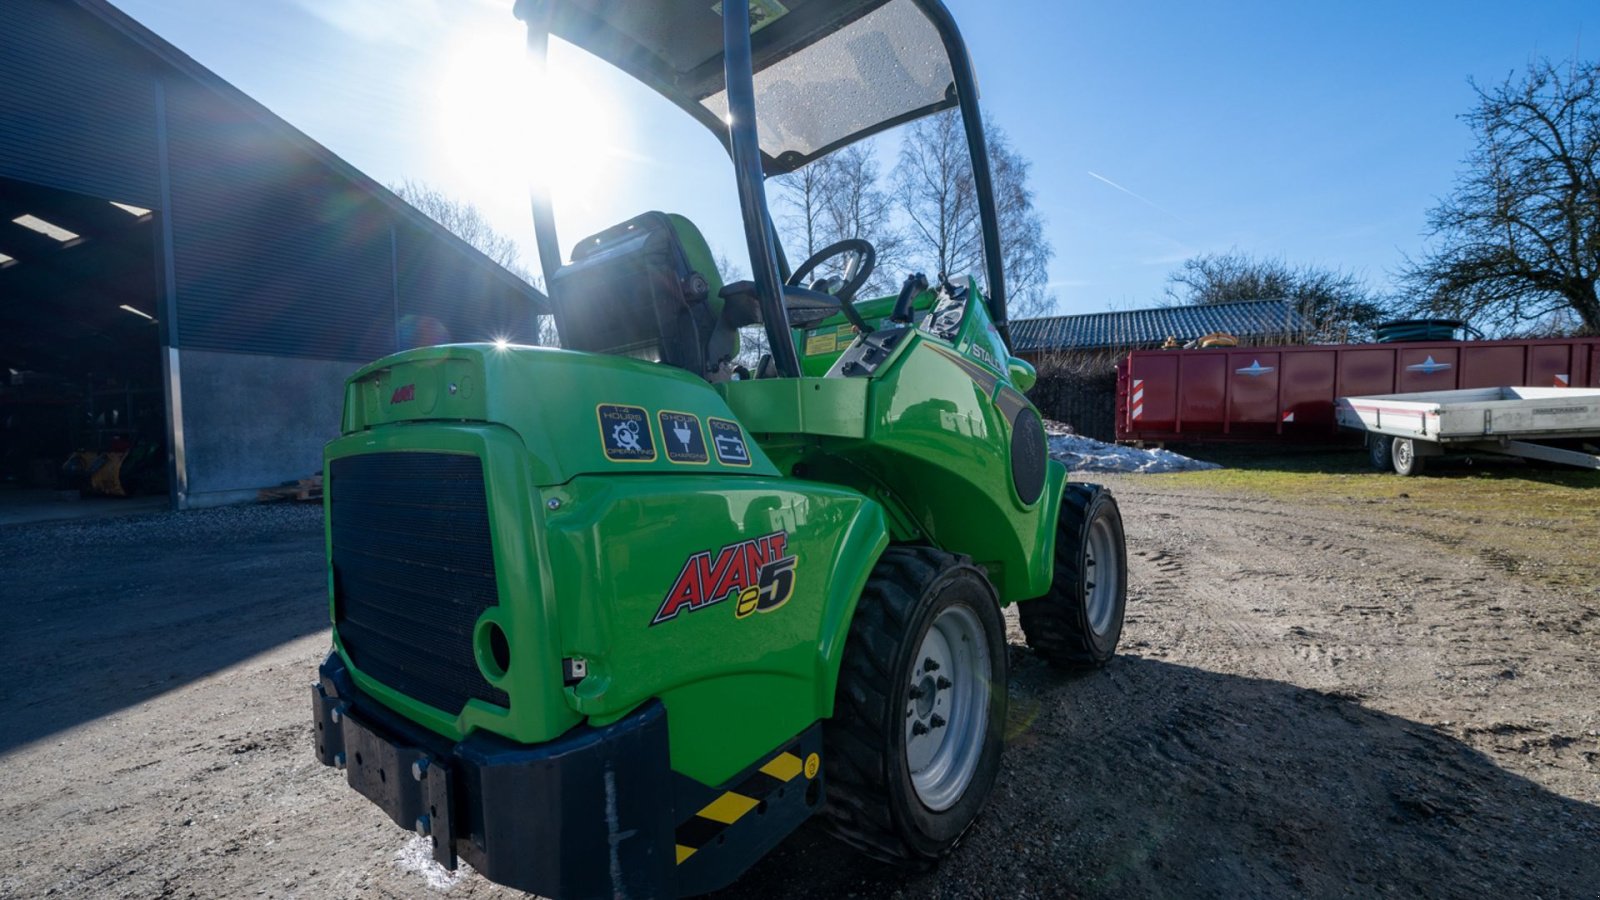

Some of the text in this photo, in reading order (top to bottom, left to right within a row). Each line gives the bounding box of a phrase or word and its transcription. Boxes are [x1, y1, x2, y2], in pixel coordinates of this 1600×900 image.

[603, 412, 642, 421] HOURS
[649, 529, 788, 627] AVANT
[735, 555, 798, 619] e5
